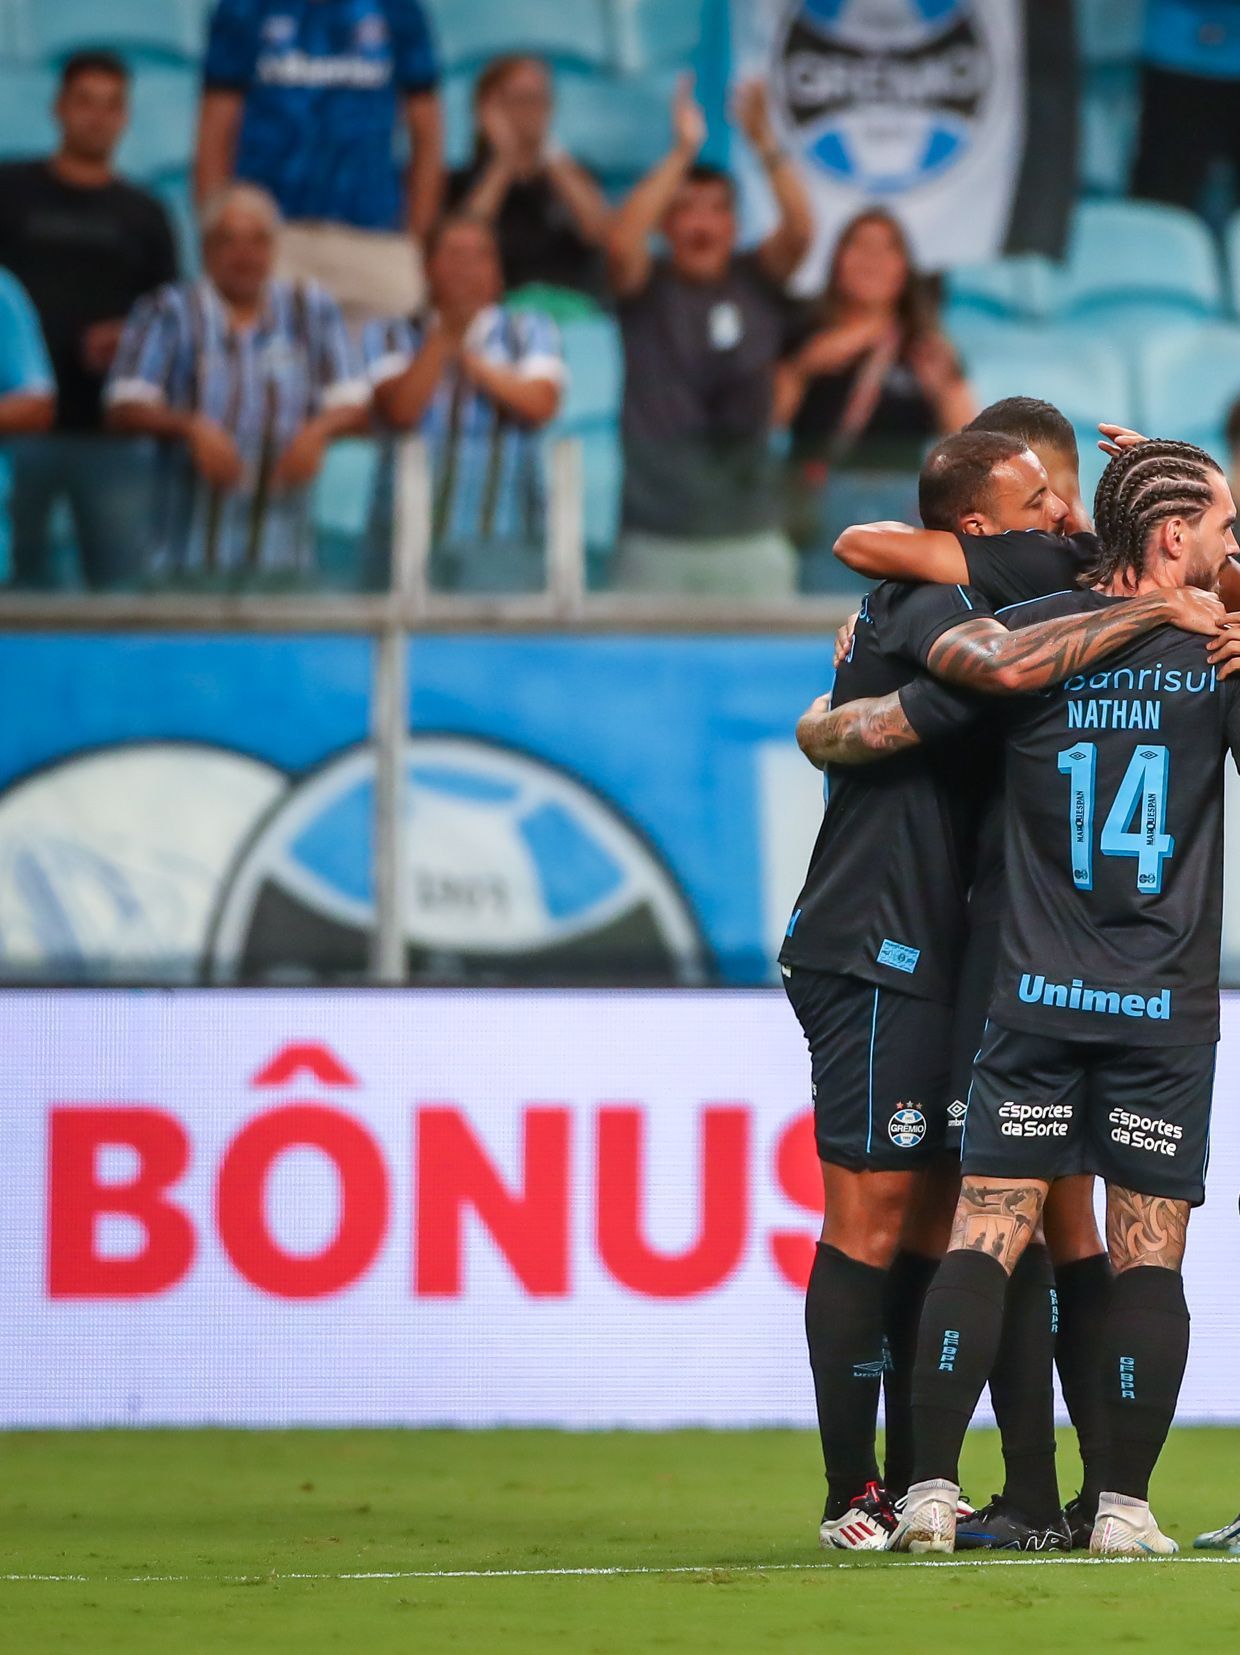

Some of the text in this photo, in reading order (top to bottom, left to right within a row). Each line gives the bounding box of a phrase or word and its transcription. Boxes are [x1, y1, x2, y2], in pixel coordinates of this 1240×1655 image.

[1067, 700, 1161, 730] NATHAN
[1057, 741, 1175, 894] 14
[1146, 793, 1157, 846] MARQUESPAN
[1018, 973, 1171, 1020] Unimed
